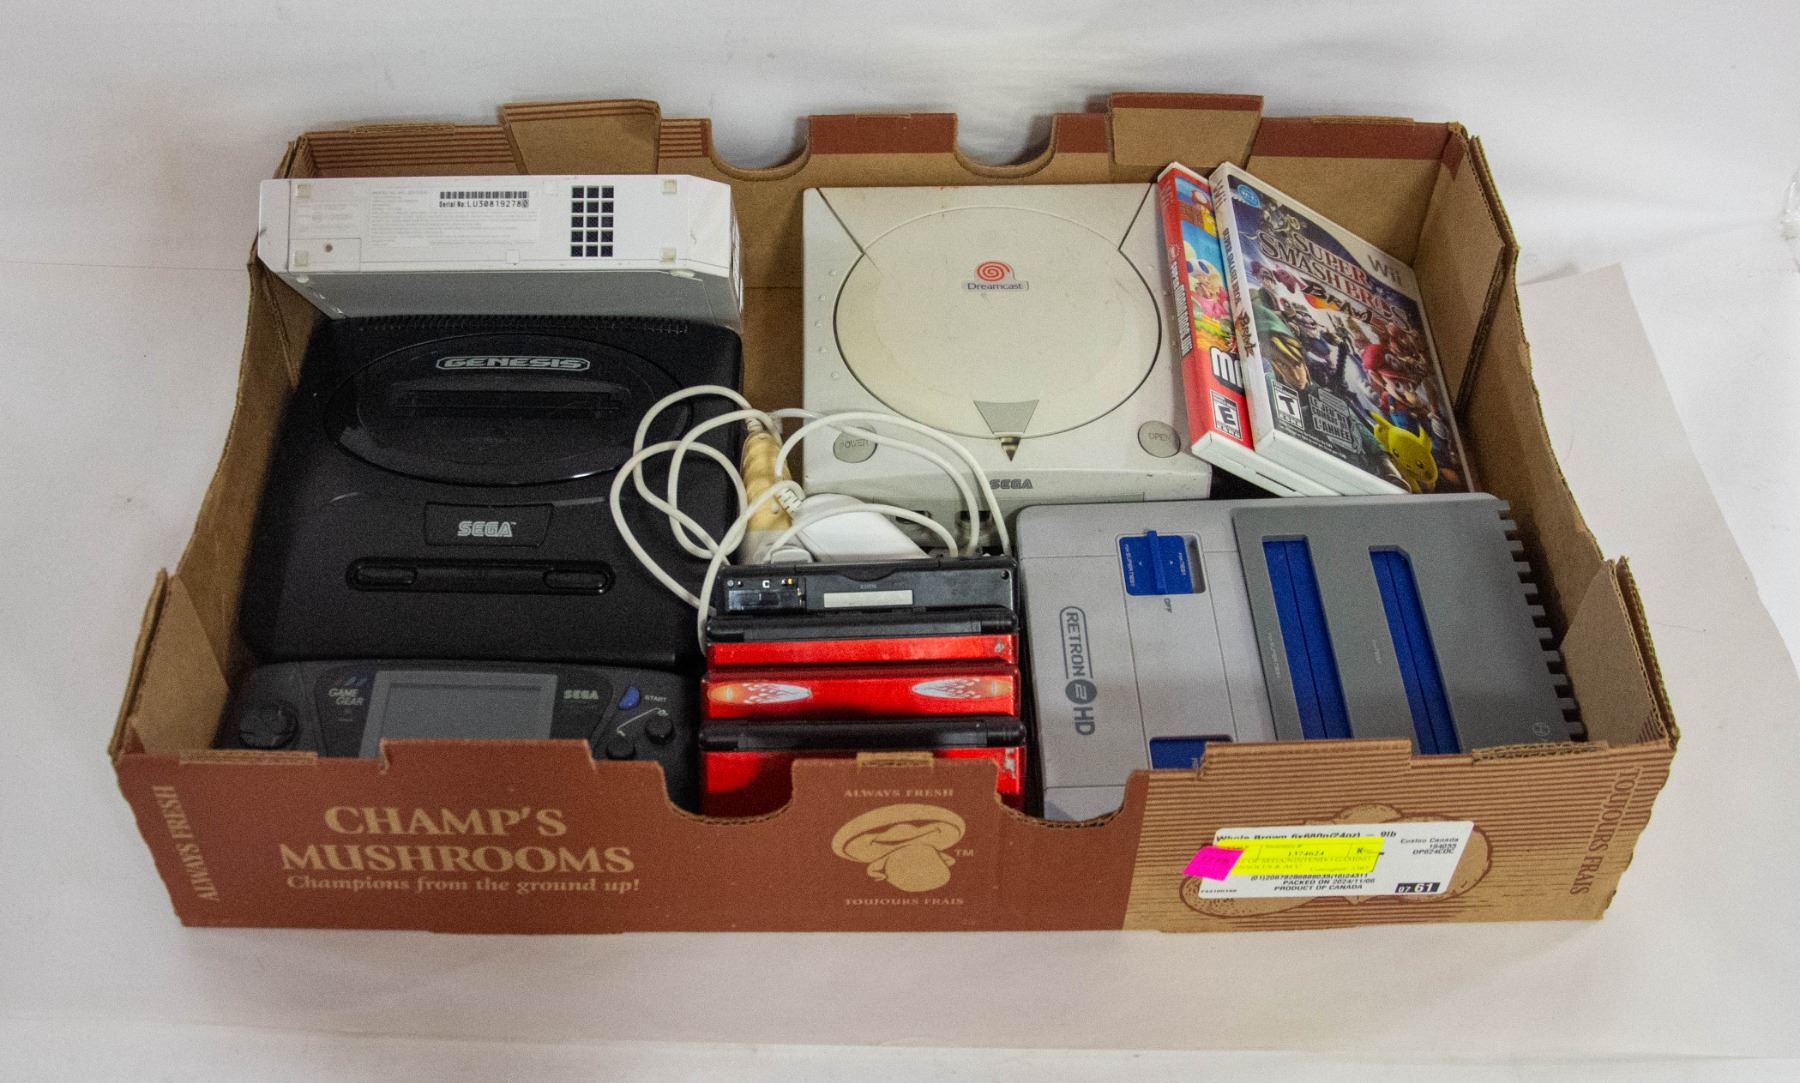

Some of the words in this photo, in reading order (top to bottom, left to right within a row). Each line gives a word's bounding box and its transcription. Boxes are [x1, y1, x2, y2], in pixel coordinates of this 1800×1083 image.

[1257, 230, 1341, 289] SMASH
[1292, 231, 1368, 287] SUPER
[1367, 254, 1402, 287] Wii
[967, 282, 1022, 290] Dreamcast
[444, 357, 585, 369] GENESIS
[1218, 405, 1236, 425] E
[1278, 395, 1295, 415] T
[990, 478, 1033, 489] SEGA
[457, 521, 513, 537] SEGA
[1066, 612, 1086, 677] RETRON
[328, 688, 358, 697] GAME
[335, 696, 364, 706] GEAR
[563, 689, 599, 700] SEGA
[1073, 706, 1095, 736] HD
[844, 788, 900, 798] ALWAYS
[905, 788, 954, 798] FRESH
[152, 785, 194, 839] FRESH
[1588, 768, 1640, 852] TOUJOURS
[324, 806, 567, 836] CHAMP'S
[279, 843, 635, 873] MUSHROOMS
[955, 849, 974, 857] TM
[176, 843, 220, 902] ALWAYS
[1570, 855, 1604, 895] FRAIS
[286, 875, 410, 892] Champions
[416, 875, 468, 894] from
[476, 876, 510, 891] the
[516, 877, 596, 896] ground
[604, 878, 640, 894] up!
[1414, 883, 1433, 892] 61
[846, 898, 920, 906] TOUJOURS
[924, 898, 964, 906] FRAIS
